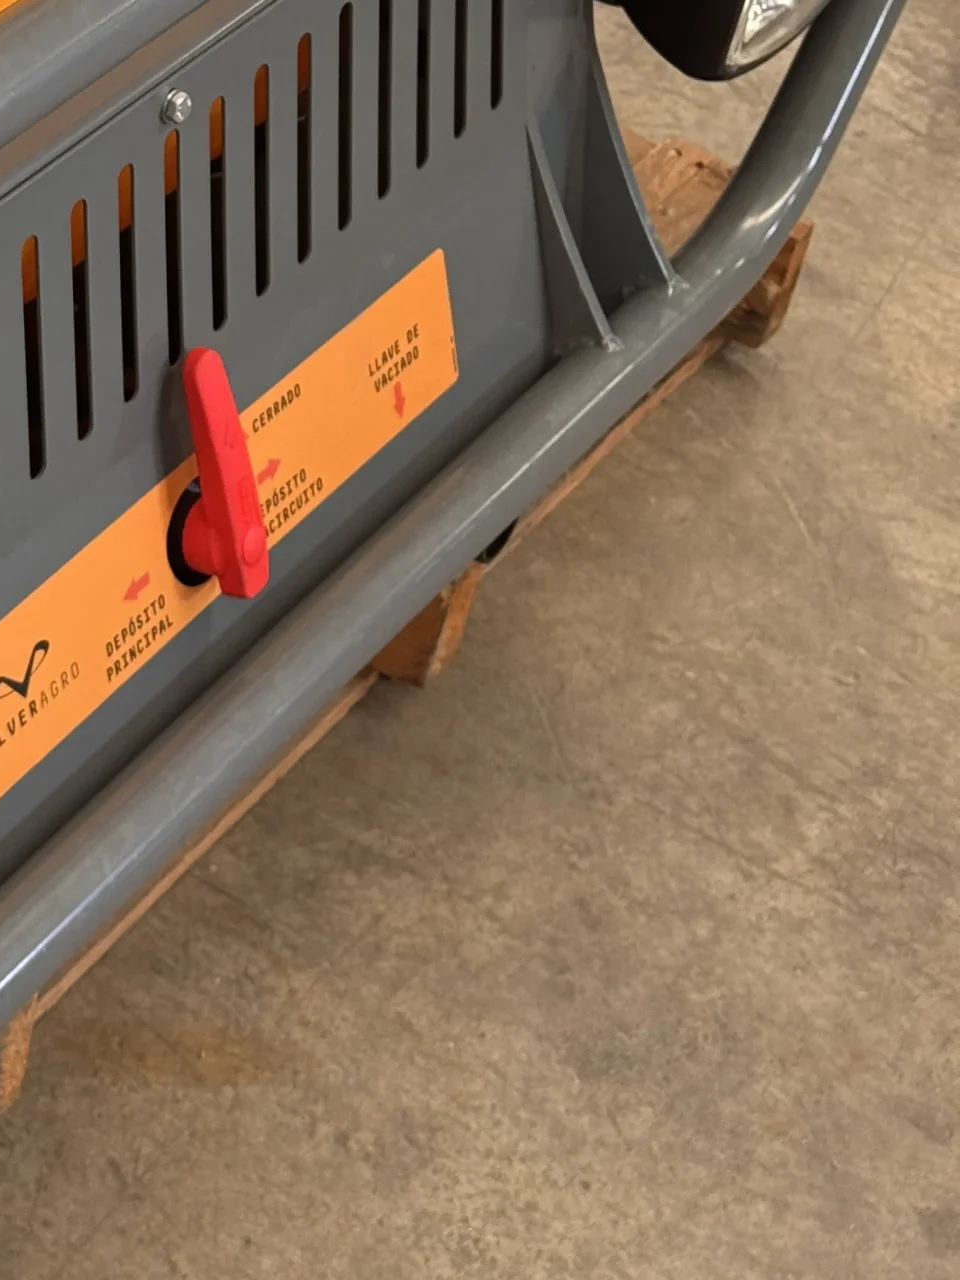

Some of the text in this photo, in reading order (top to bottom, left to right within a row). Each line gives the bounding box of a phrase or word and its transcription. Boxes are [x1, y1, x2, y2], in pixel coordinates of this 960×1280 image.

[368, 323, 420, 377] LLAVE DE
[374, 346, 419, 392] VACIADO
[252, 383, 301, 433] CERRADO
[260, 468, 307, 518] EPÓSITO
[265, 477, 323, 538] CIRCUITO
[106, 594, 166, 657] DEPÓSITO
[106, 616, 174, 681] PRINCIPAL
